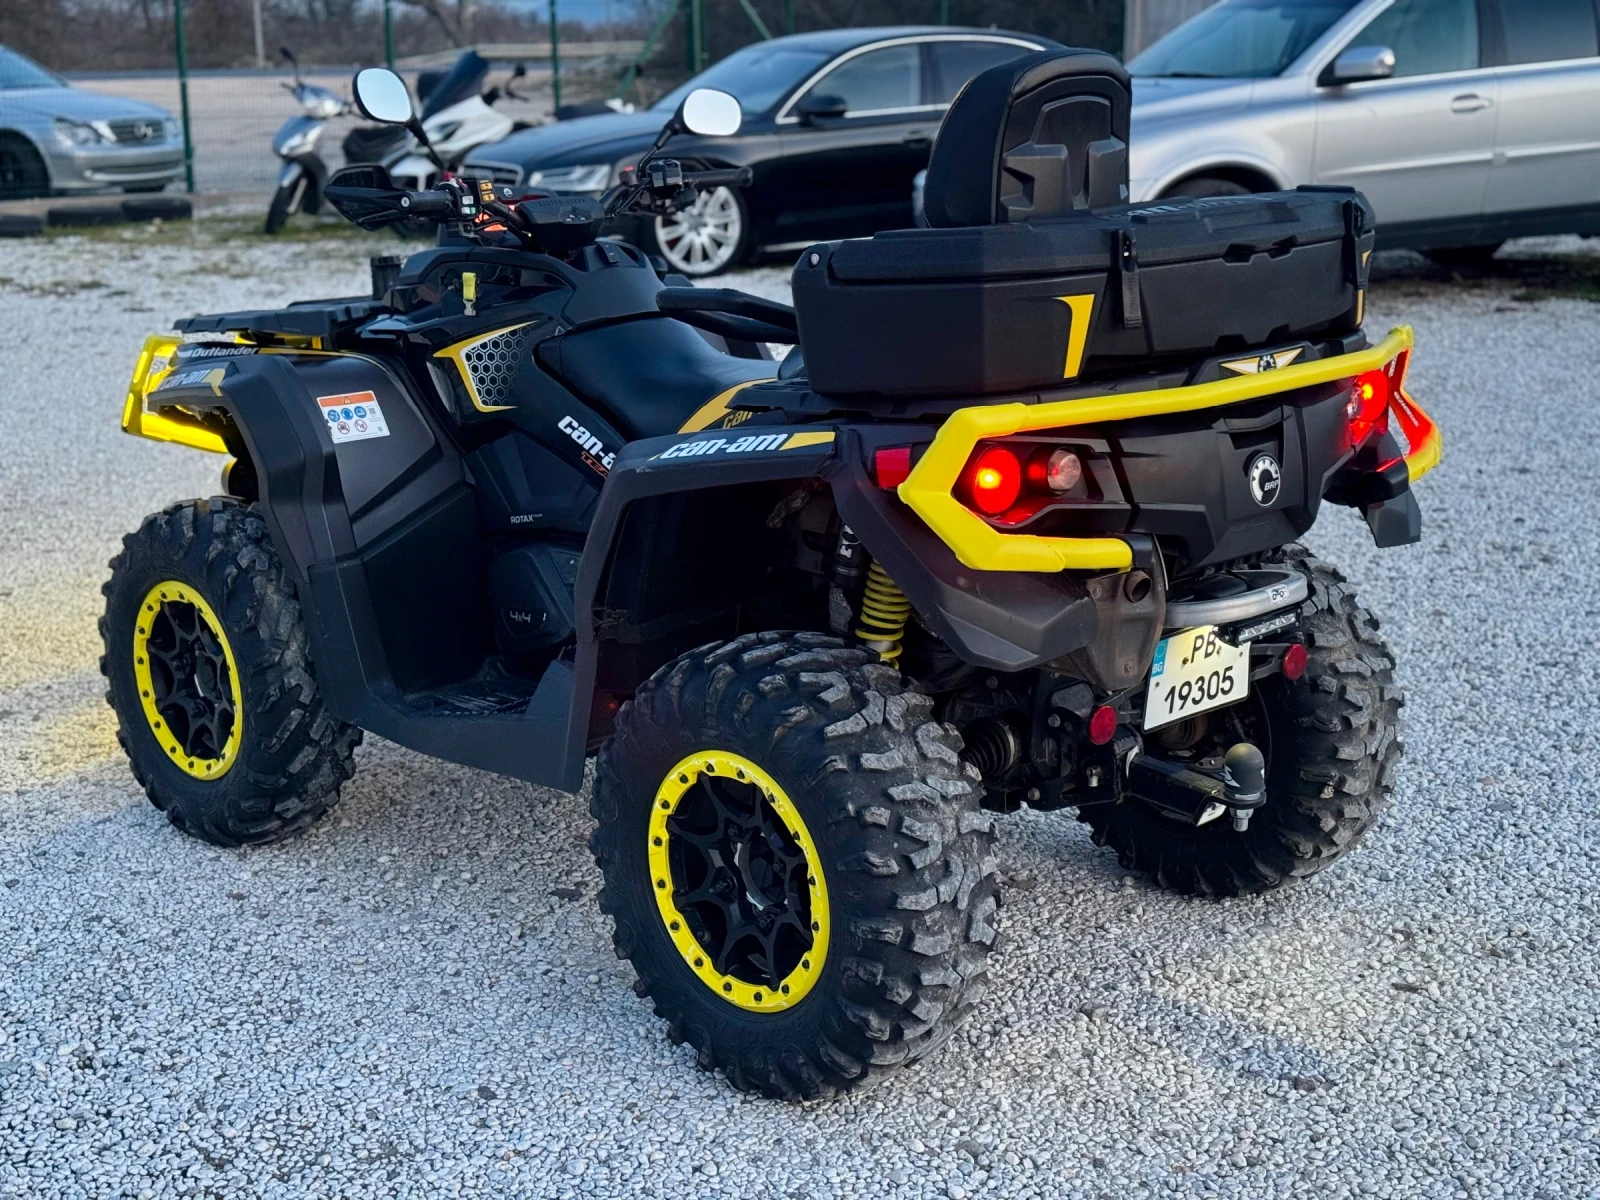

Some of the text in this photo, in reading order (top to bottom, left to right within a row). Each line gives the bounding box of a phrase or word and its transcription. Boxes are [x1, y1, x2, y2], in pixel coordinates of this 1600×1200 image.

[191, 347, 259, 357] Outlander
[159, 370, 211, 390] can-am
[722, 410, 753, 429] can
[557, 415, 616, 470] can-a
[660, 433, 789, 460] can-am
[581, 451, 608, 479] TEA
[510, 514, 534, 524] ROTAX
[1152, 662, 1163, 673] BG
[1164, 665, 1234, 714] 19305
